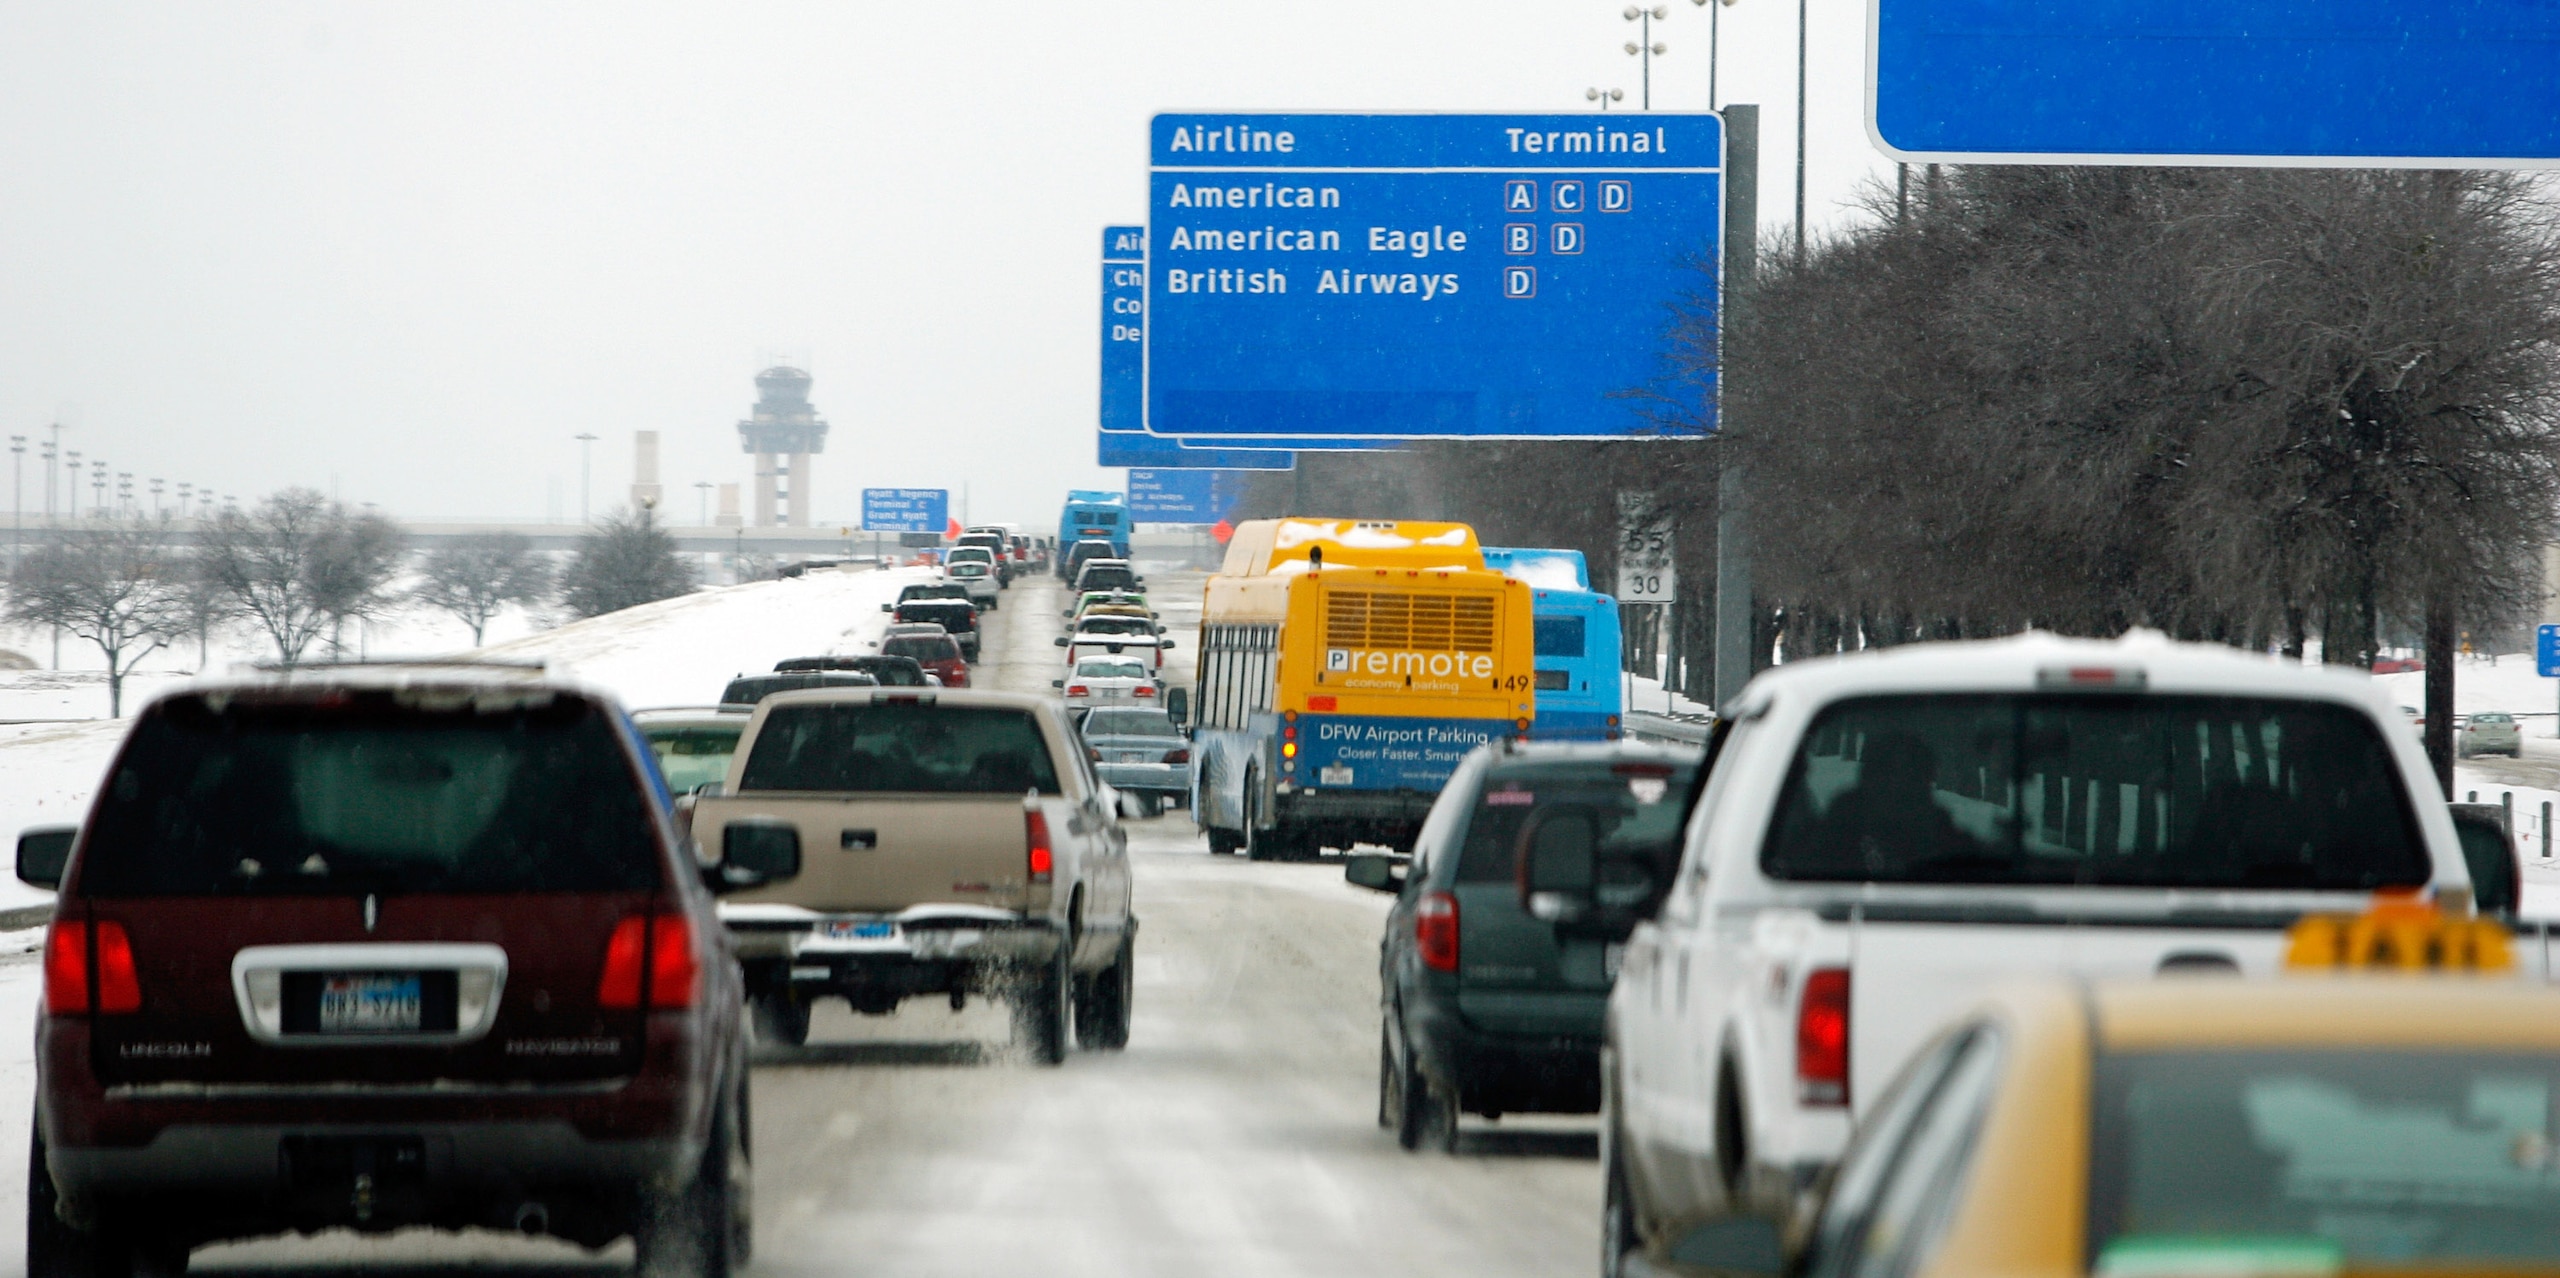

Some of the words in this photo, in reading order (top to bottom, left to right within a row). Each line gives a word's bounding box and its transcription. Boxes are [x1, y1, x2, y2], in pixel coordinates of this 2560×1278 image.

[1171, 126, 1294, 153] Airline
[1507, 127, 1666, 153] Terminal
[1170, 183, 1339, 208] American
[1512, 184, 1531, 209] A
[1558, 184, 1577, 209] C
[1605, 184, 1624, 209] D
[1170, 226, 1339, 251] American
[1369, 226, 1467, 258] Eagle
[1511, 227, 1530, 252] B
[1558, 226, 1577, 251] D
[1169, 268, 1286, 294] British
[1317, 270, 1460, 301] Airways
[1511, 270, 1530, 295] D
[868, 490, 894, 499] Hyatt
[900, 490, 939, 500] Regency
[868, 500, 911, 509] Terminal
[868, 511, 897, 520] Grand
[902, 512, 929, 521] Hyatt
[868, 522, 911, 531] Terminal
[1632, 576, 1660, 594] 30
[1351, 650, 1494, 679] remote
[1345, 678, 1403, 692] economy
[1412, 679, 1460, 695] parking
[1504, 675, 1529, 692] 49
[1320, 724, 1362, 740] DFW
[1365, 726, 1424, 745] Airport
[1338, 746, 1378, 760] Closer.
[1382, 748, 1421, 761] Faster.
[120, 1042, 212, 1058] LINCOLN
[505, 1038, 620, 1056] NAVIGATOR
